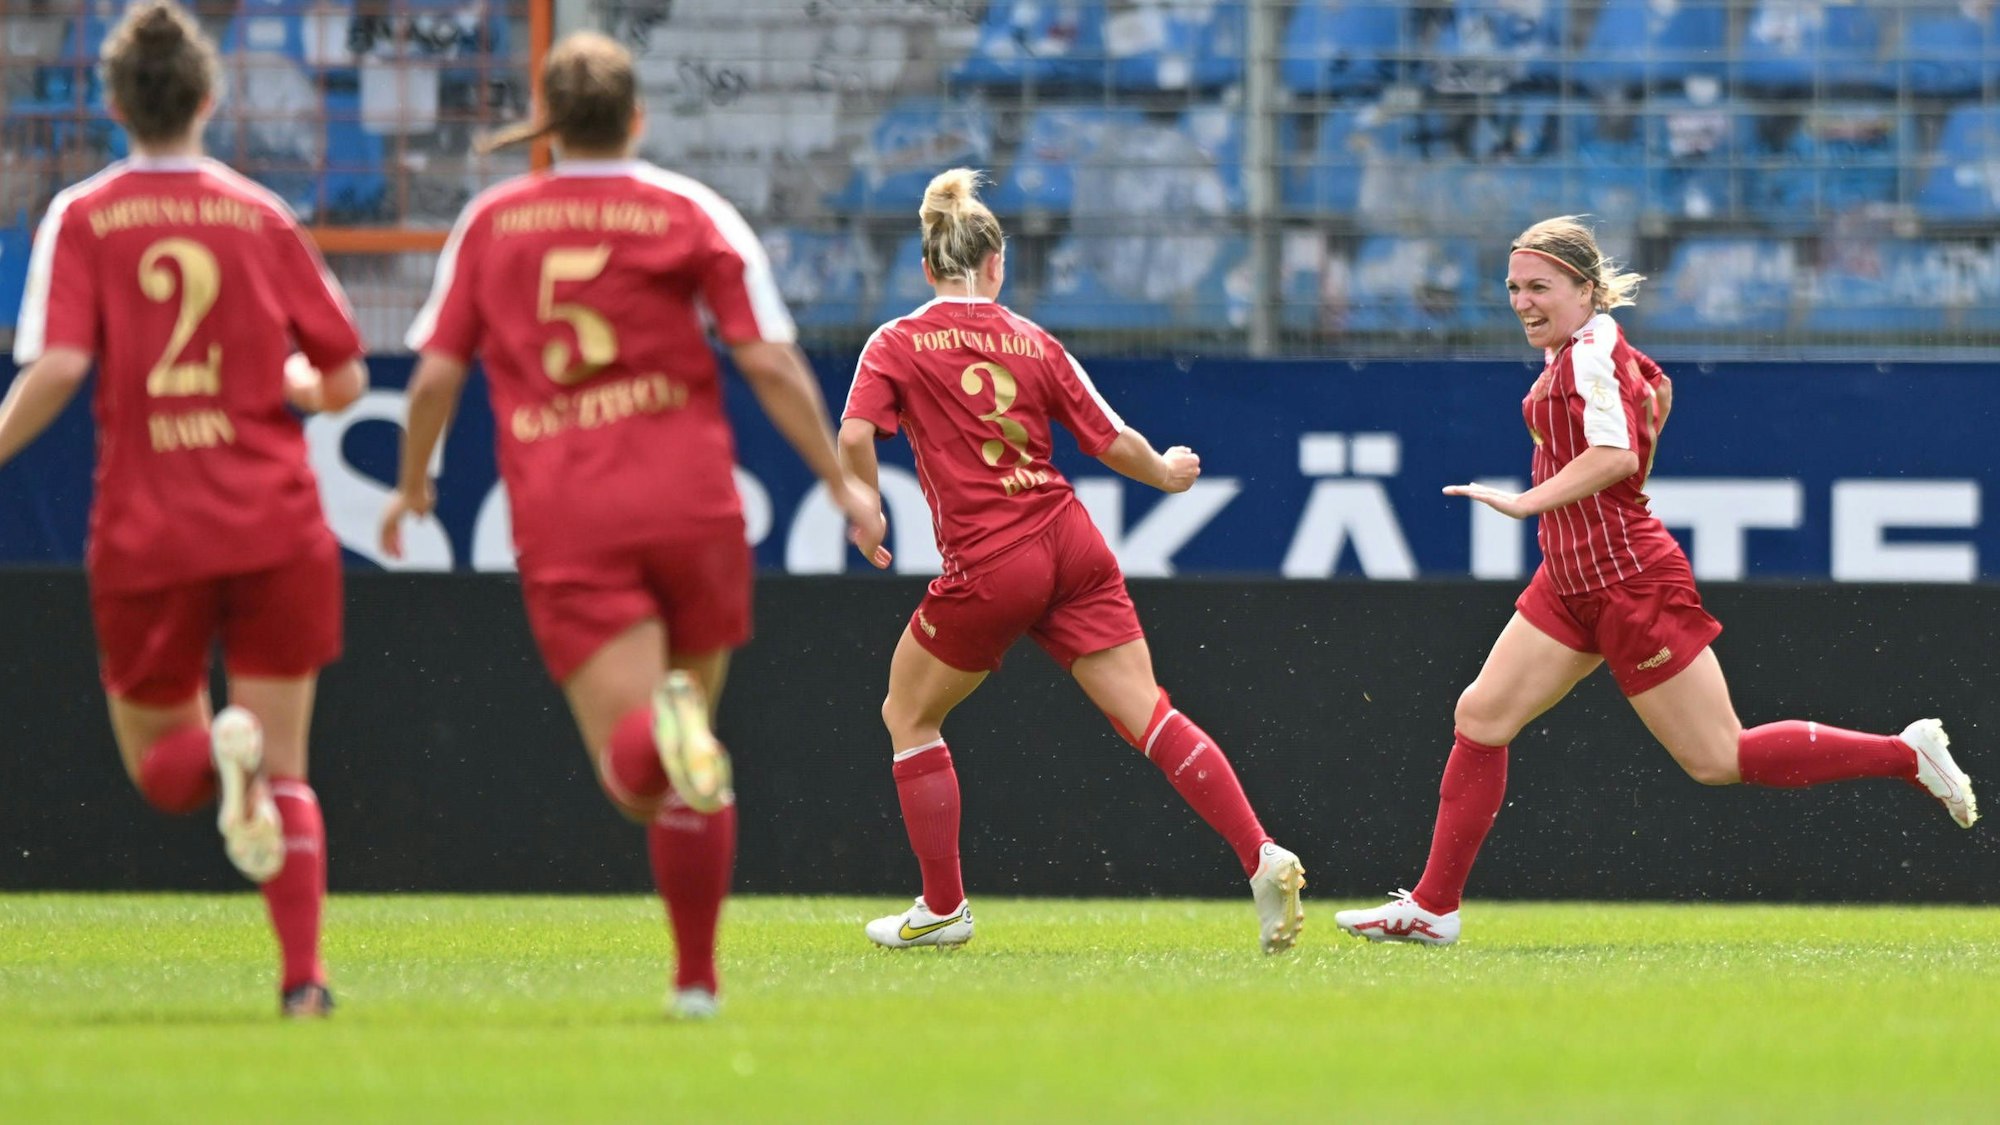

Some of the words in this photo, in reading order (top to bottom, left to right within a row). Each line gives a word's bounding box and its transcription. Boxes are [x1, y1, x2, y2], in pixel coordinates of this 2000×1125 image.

[138, 236, 222, 397] 2
[537, 240, 617, 385] 5
[912, 328, 995, 353] FORTUNA
[1000, 331, 1045, 361] KÖLN
[961, 361, 1033, 470] 3
